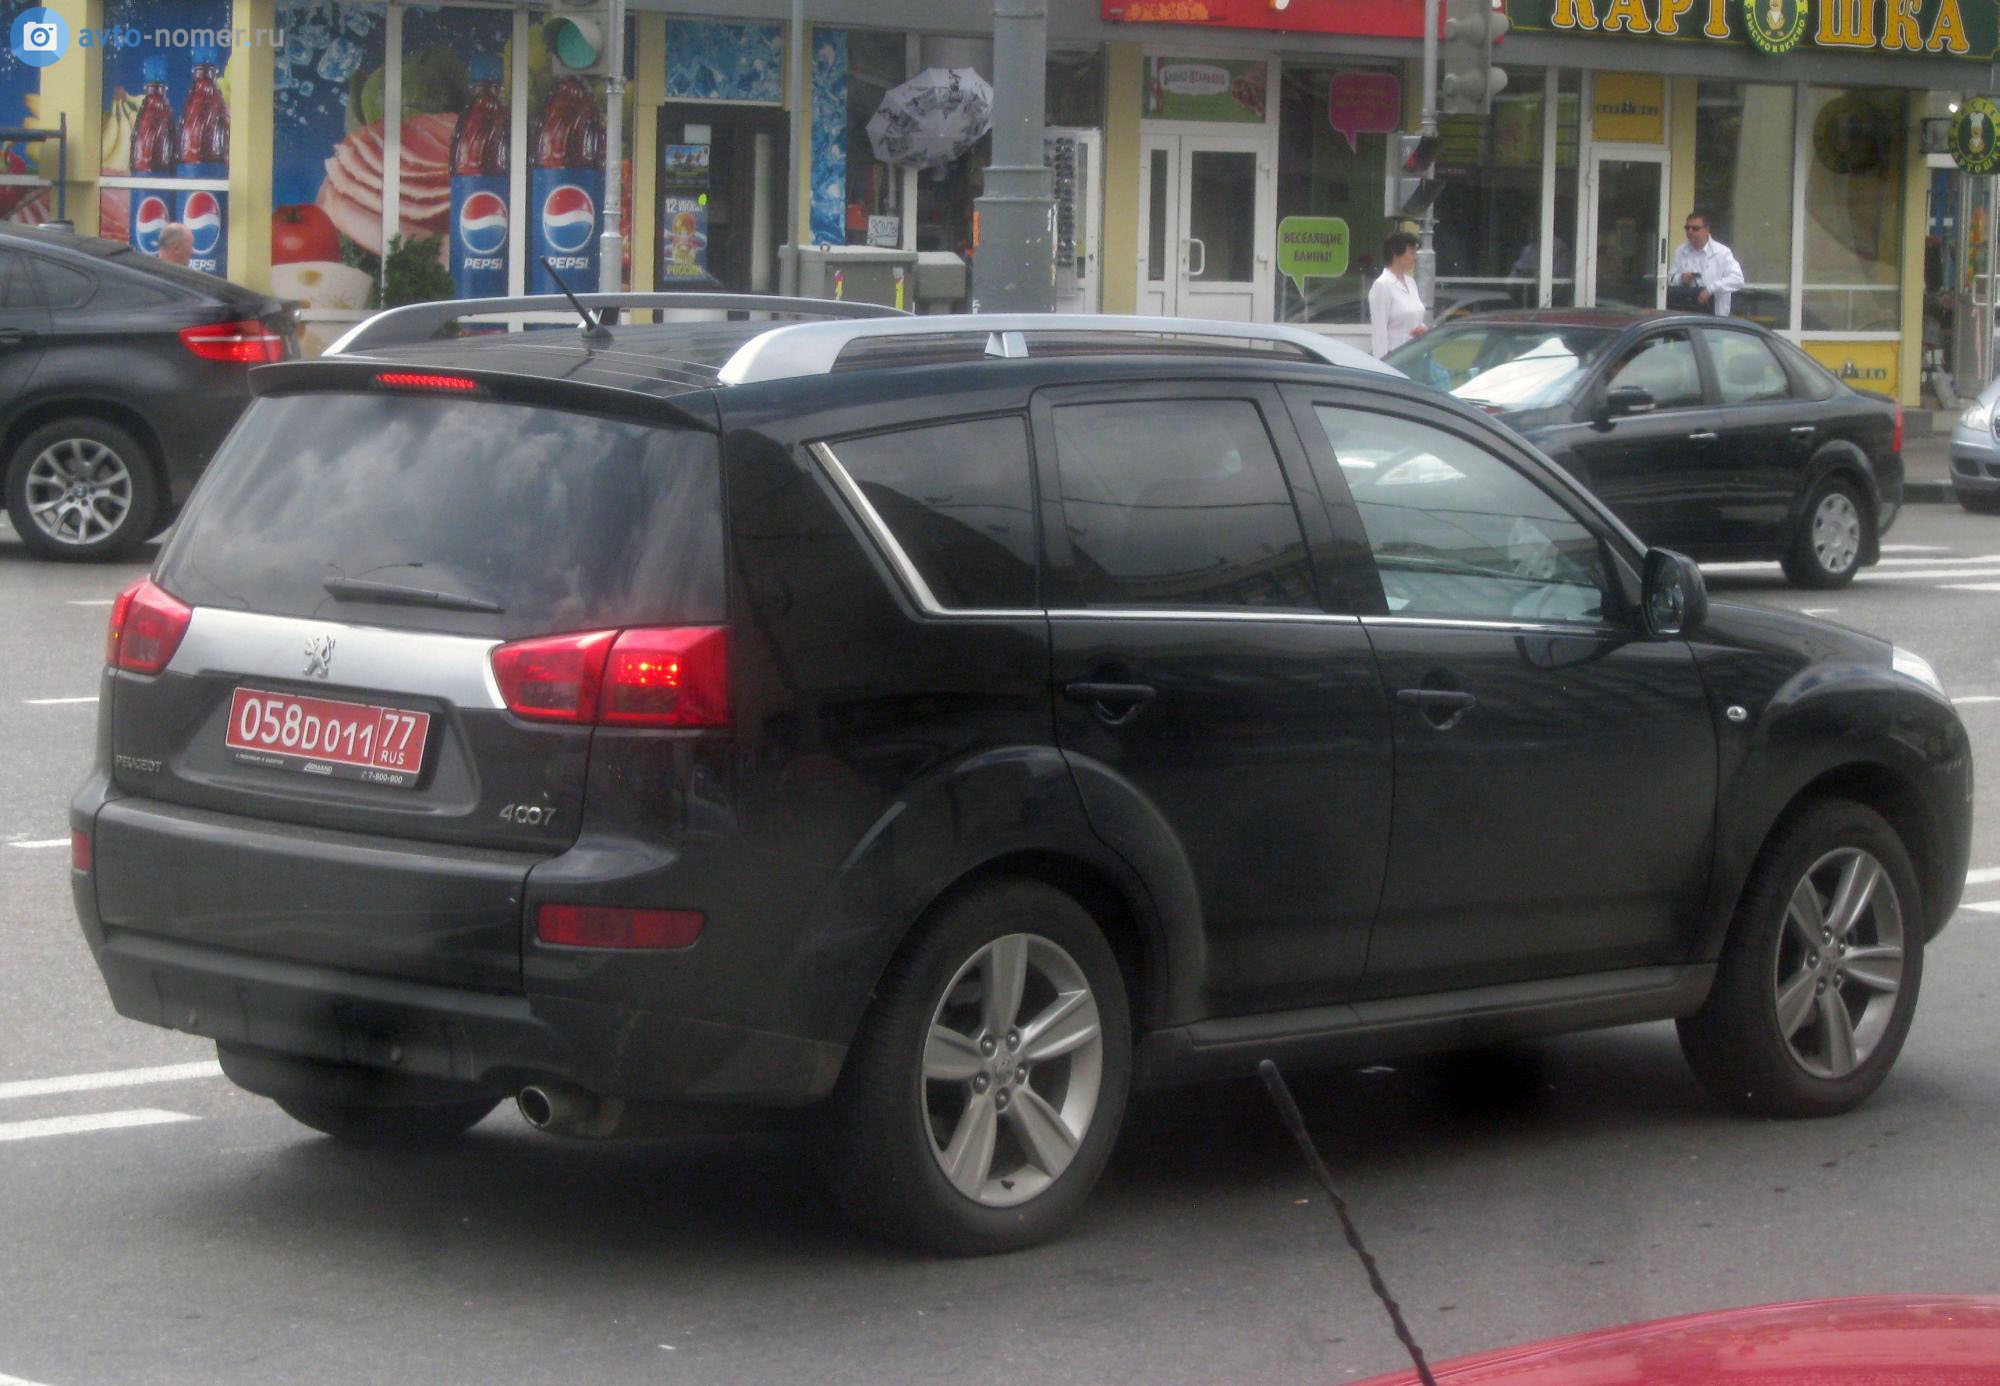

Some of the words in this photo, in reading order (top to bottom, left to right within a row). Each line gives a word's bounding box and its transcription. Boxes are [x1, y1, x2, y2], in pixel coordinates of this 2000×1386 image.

[464, 256, 503, 270] PEPSI
[380, 749, 405, 765] RUS
[499, 803, 557, 826] 4007
